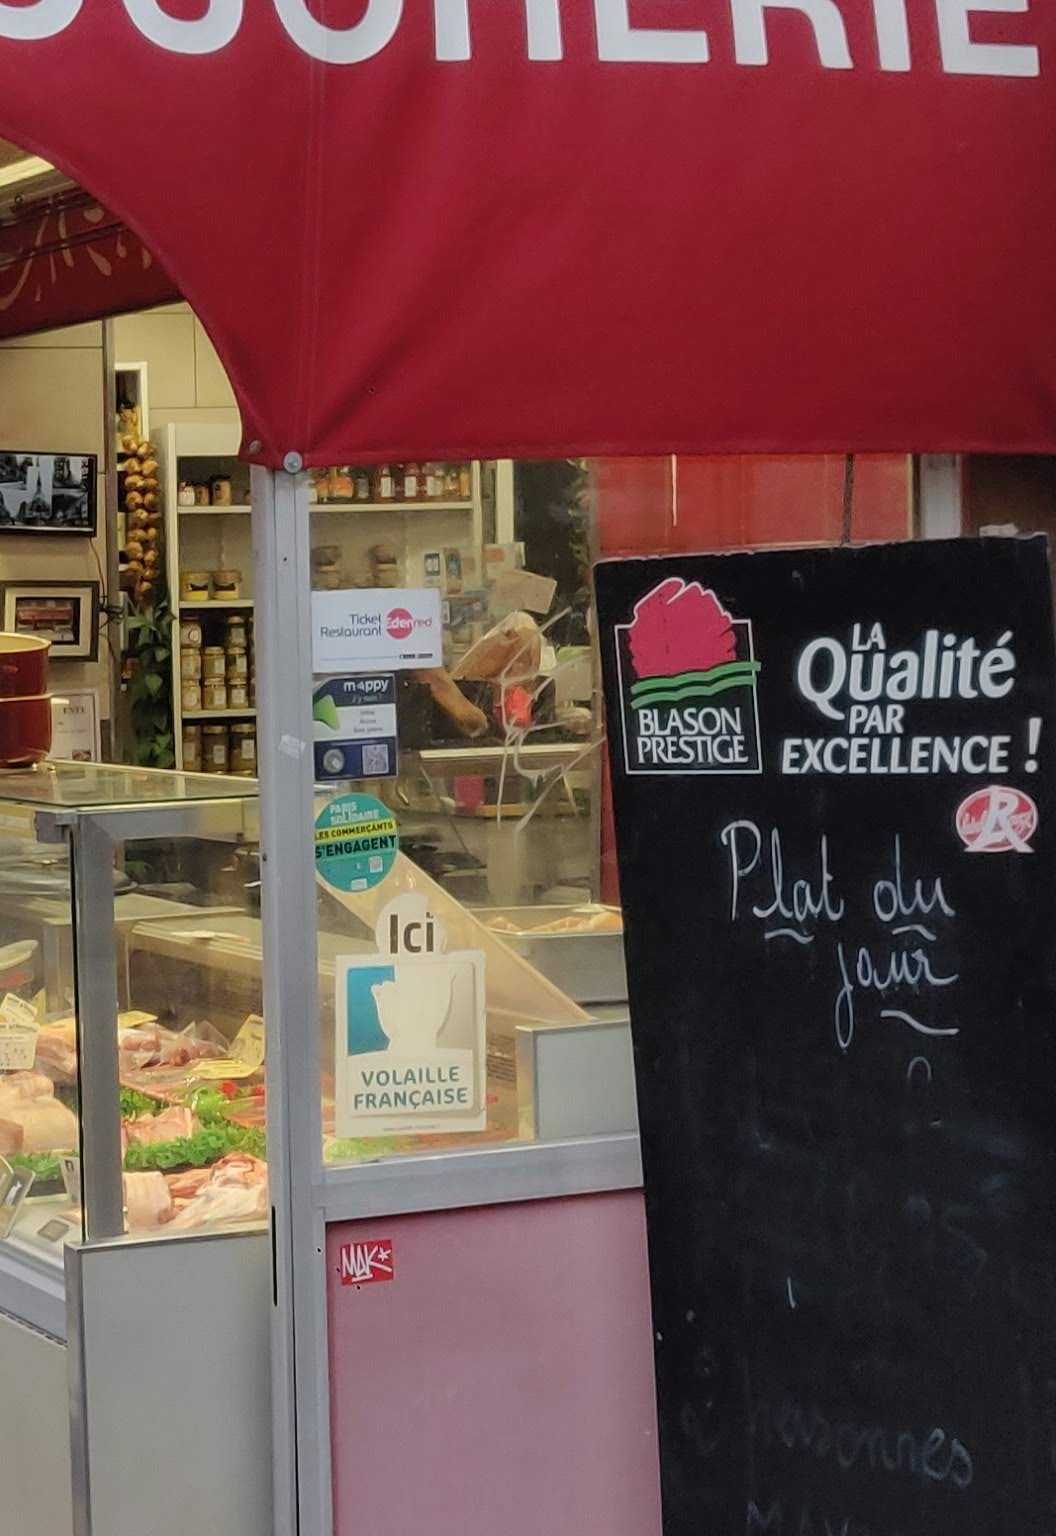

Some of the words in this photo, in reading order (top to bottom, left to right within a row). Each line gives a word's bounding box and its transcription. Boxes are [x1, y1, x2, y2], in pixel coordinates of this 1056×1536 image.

[320, 626, 382, 638] Restaurant
[349, 614, 382, 626] Ticket
[852, 622, 886, 651] LA
[797, 629, 1016, 721] Qualité
[638, 707, 742, 736] BLASON
[849, 704, 905, 735] PAR
[636, 735, 749, 764] PRESTIGE
[782, 735, 1012, 775] EXCELLENCE
[330, 802, 357, 814] PARIS
[330, 809, 380, 825] SOLIDAIRE
[331, 822, 394, 838] COMMERÇANTS
[315, 835, 397, 859] S'ENGAGENT
[721, 820, 844, 921] Plat
[873, 833, 956, 922] du
[389, 912, 434, 954] Ici
[360, 1066, 460, 1087] VOLAILLE
[353, 1087, 468, 1110] FRANÇAISE
